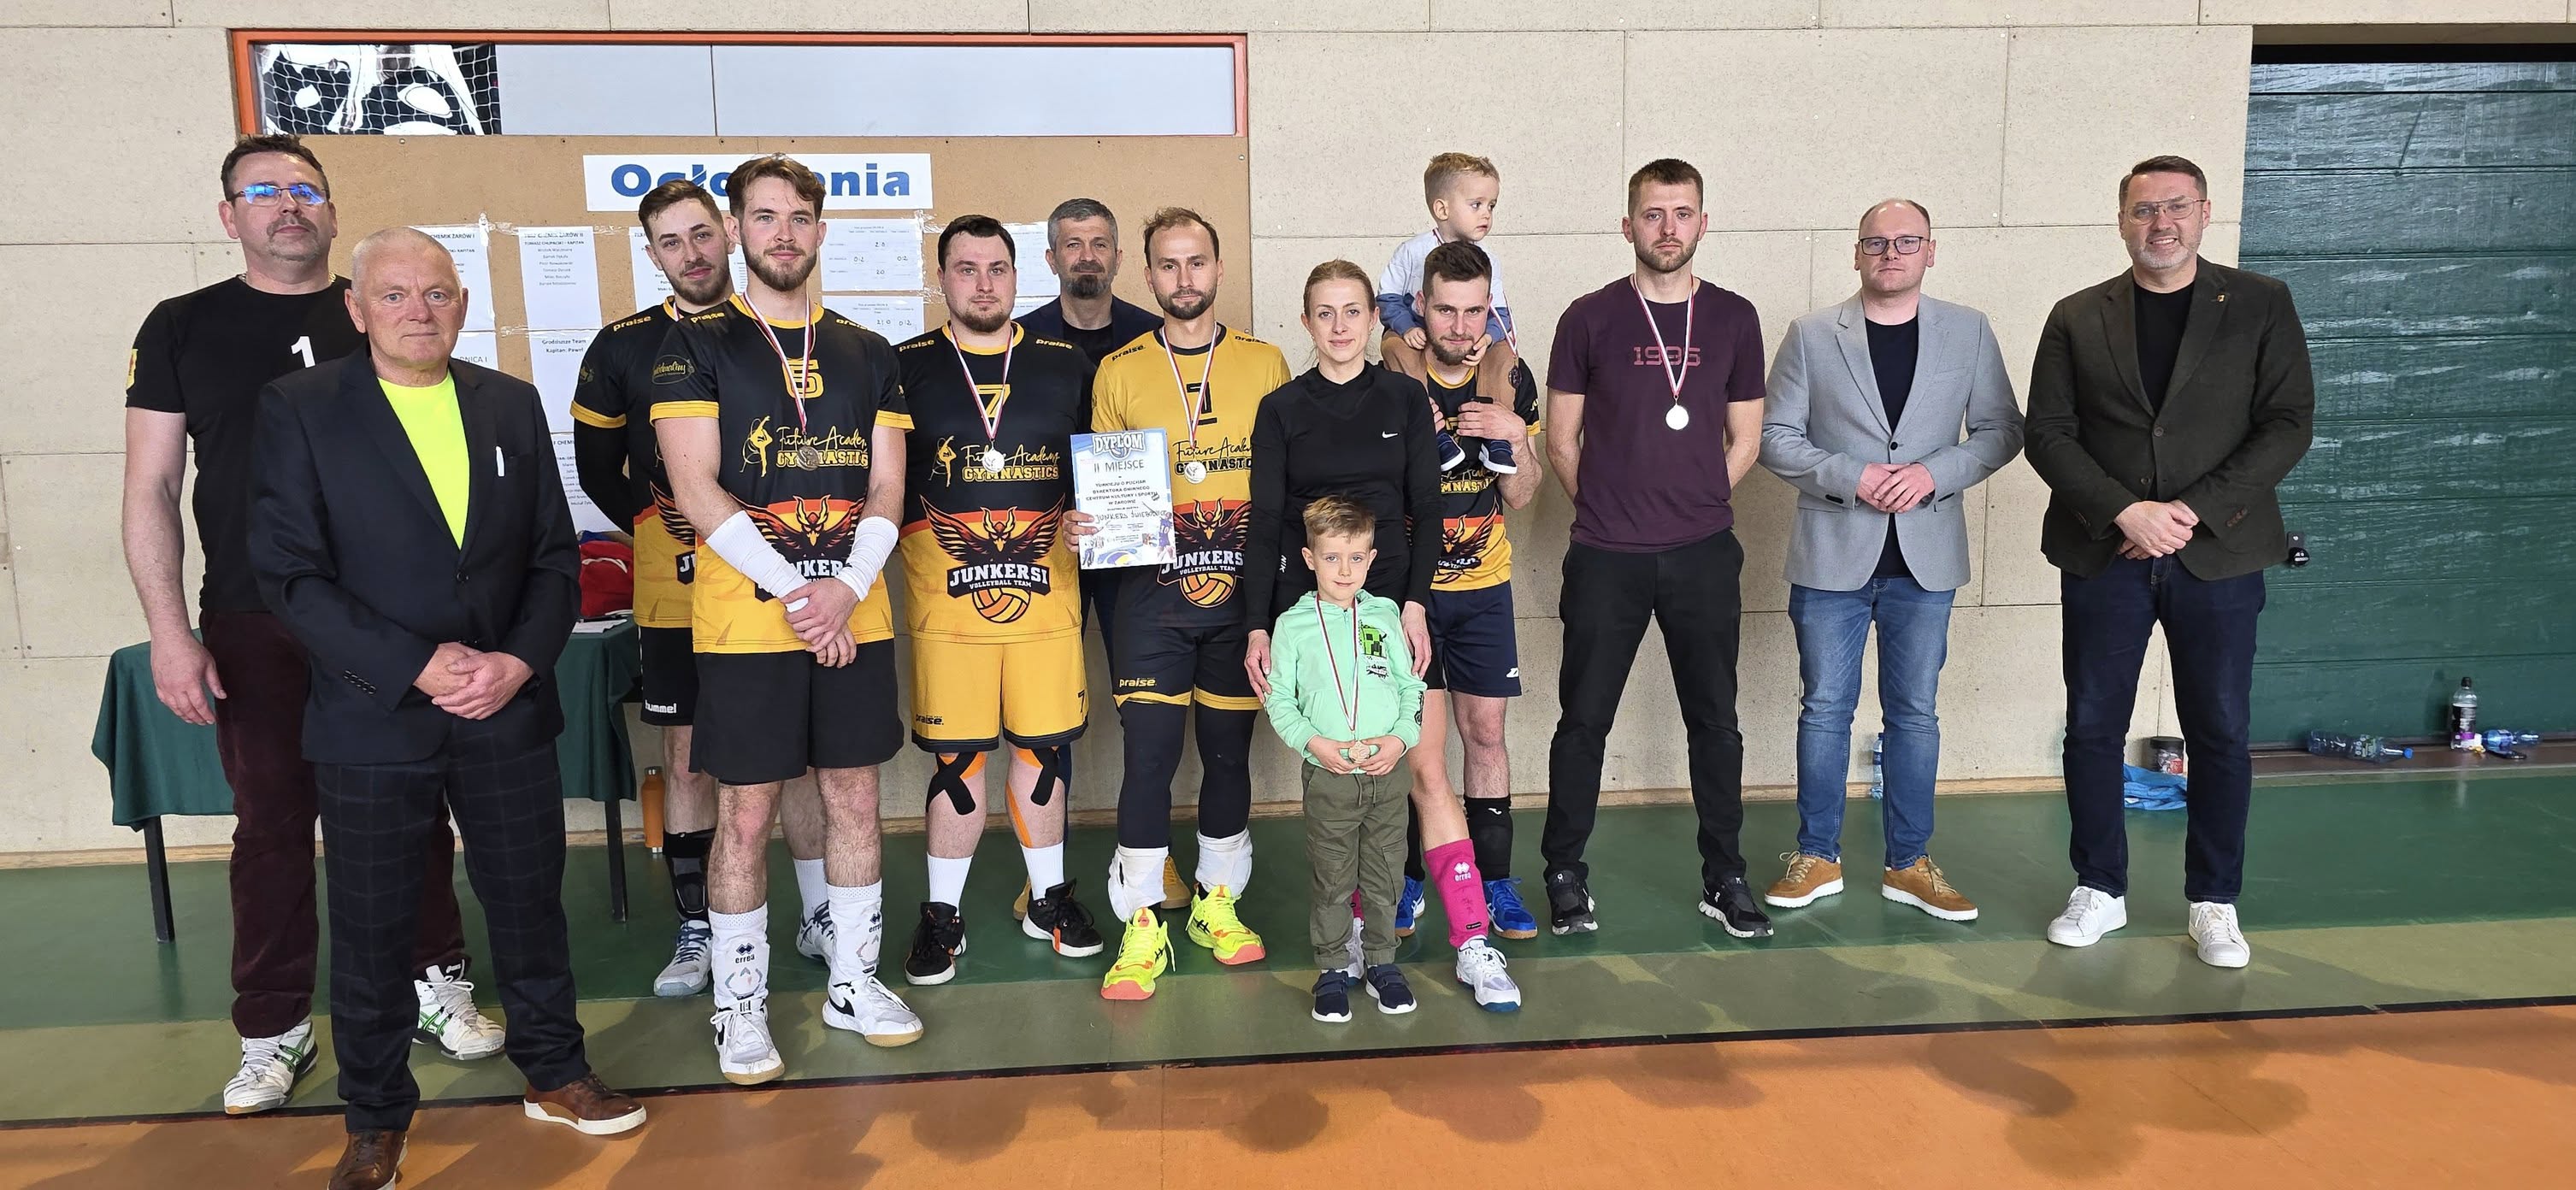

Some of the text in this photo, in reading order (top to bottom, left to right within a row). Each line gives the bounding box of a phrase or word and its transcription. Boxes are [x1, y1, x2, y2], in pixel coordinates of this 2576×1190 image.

[611, 162, 911, 197] Ołonia
[613, 315, 651, 332] praise
[290, 335, 316, 368] 1
[899, 339, 934, 353] praise
[1035, 338, 1073, 351] praise
[975, 383, 1011, 418] 7
[1093, 433, 1145, 454] DYPLOM
[963, 464, 1059, 481] GYMNASTICS
[1105, 459, 1145, 473] MIEJSCE
[1161, 550, 1245, 574] JUNKERS
[1180, 565, 1218, 575] VOLLEYBALL
[1279, 554, 1288, 574] NIK
[949, 563, 1048, 587] JUNKERSI
[969, 580, 1032, 590] VOLLEYBALL TEAM
[645, 703, 677, 715] hummel
[734, 953, 755, 964] errea
